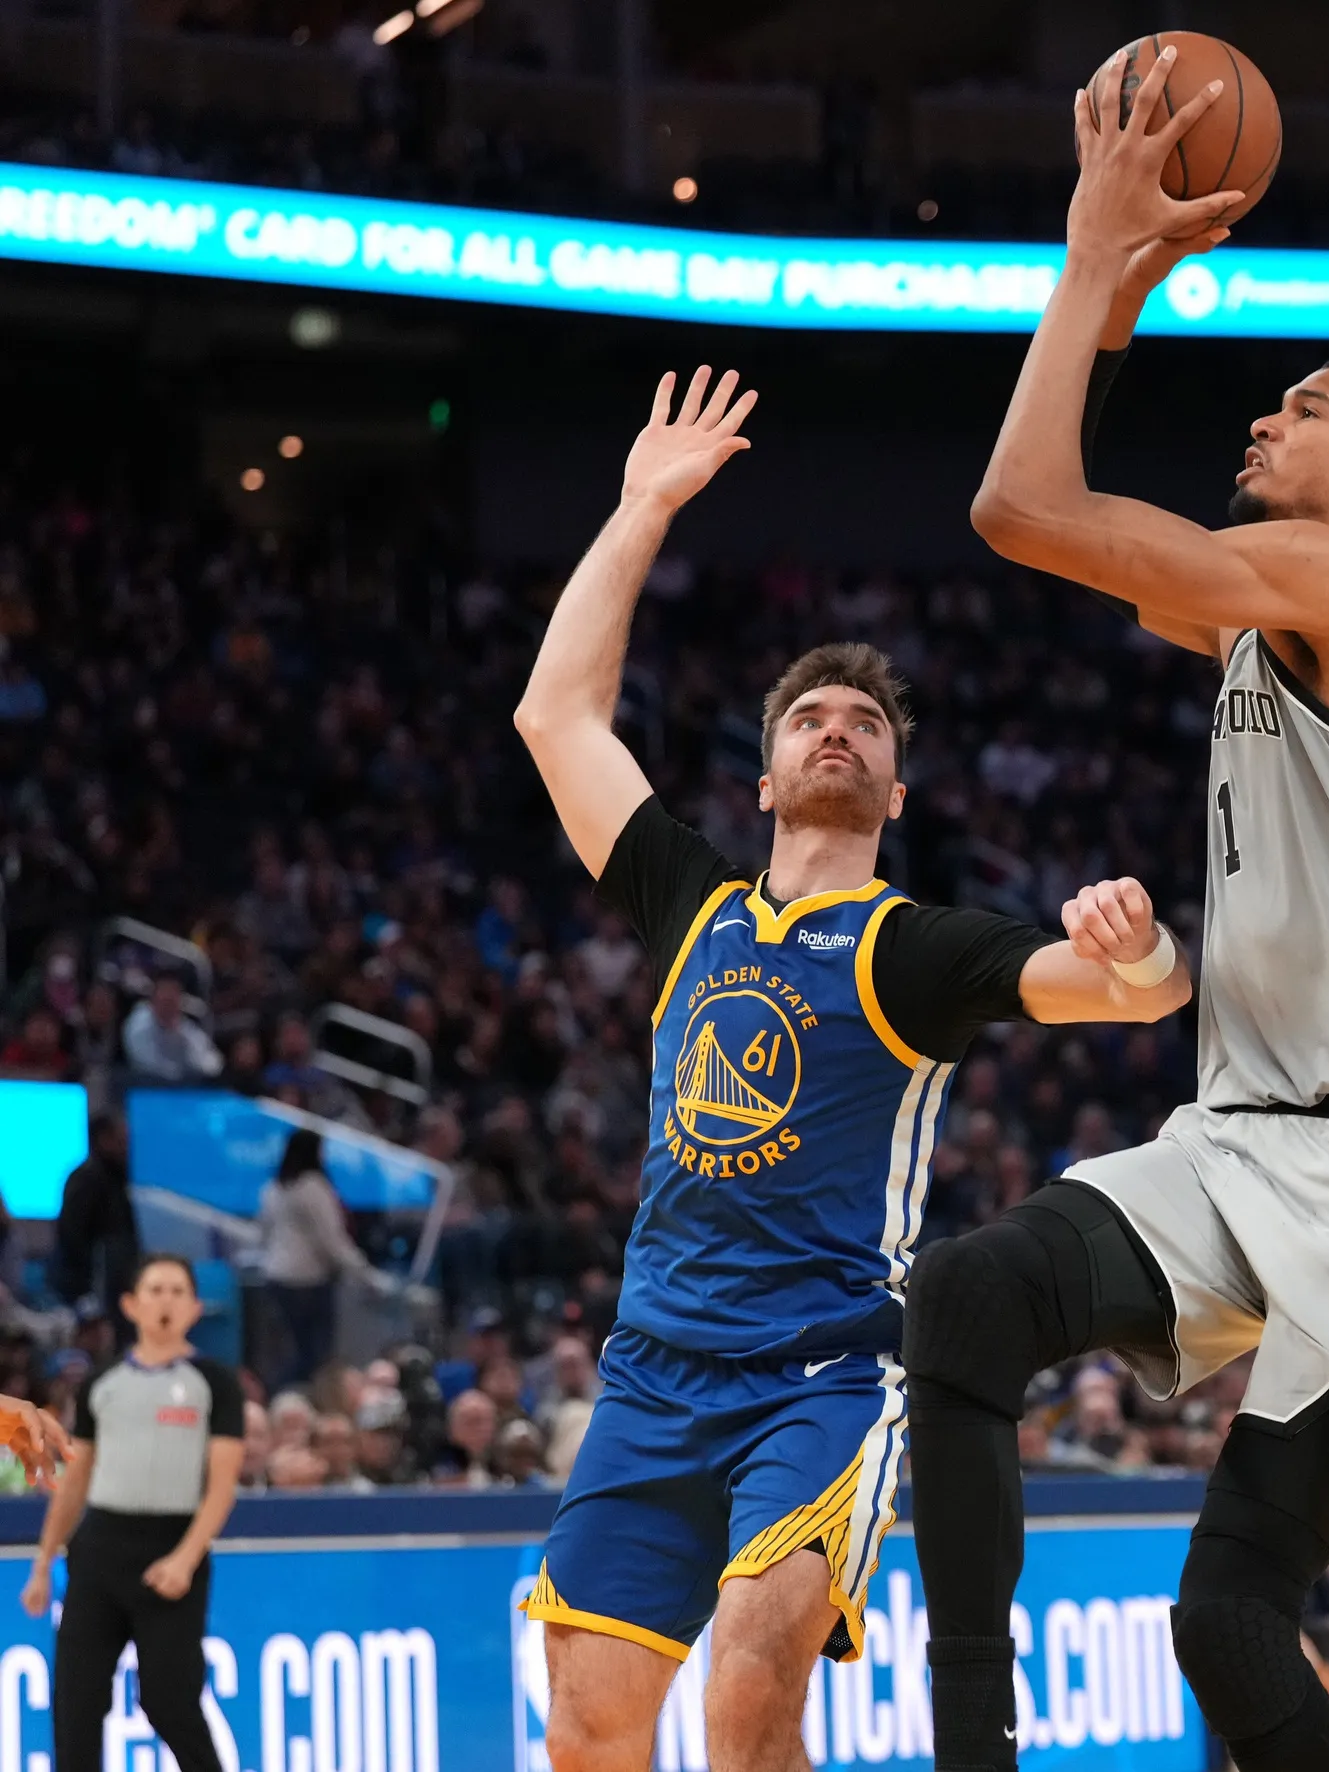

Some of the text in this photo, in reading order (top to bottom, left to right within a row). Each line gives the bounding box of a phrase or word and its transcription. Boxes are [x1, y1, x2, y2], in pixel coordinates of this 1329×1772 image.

[224, 208, 357, 267] CARD
[362, 221, 454, 276] FOR
[457, 231, 547, 286] ALL
[549, 240, 683, 299] GAME
[685, 253, 782, 305] DAY
[1216, 778, 1242, 880] 1
[798, 929, 856, 949] Rakuten
[688, 966, 819, 1031] GOLDEN STATE
[742, 1029, 781, 1077] 61
[663, 1107, 801, 1179] WARRIORS
